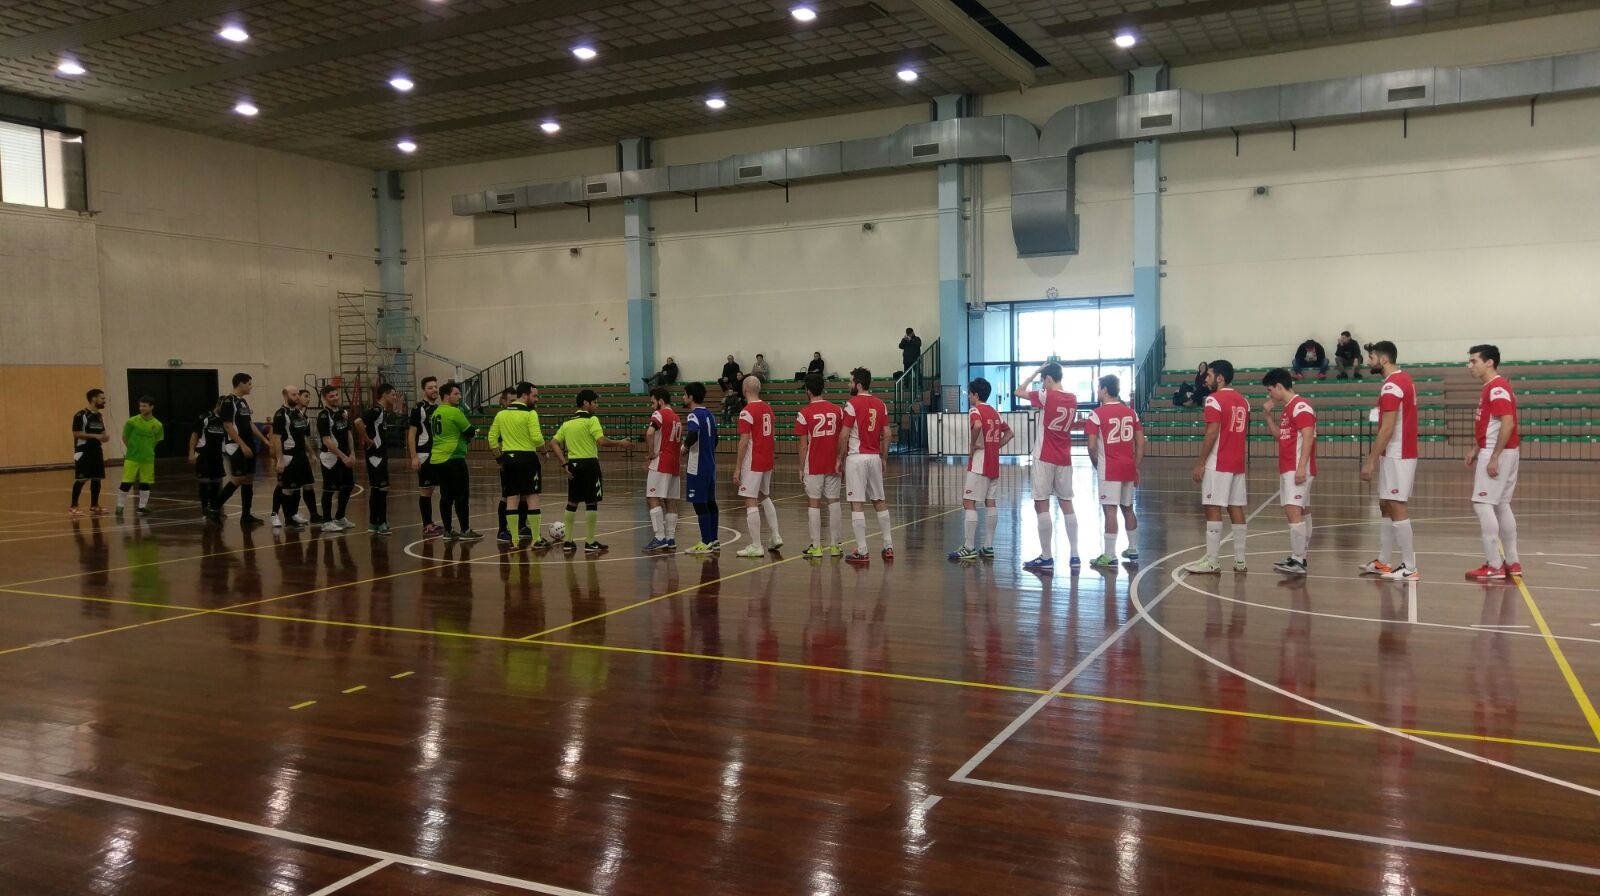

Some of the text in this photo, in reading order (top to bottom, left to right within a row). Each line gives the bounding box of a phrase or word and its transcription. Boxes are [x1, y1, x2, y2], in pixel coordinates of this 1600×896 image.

[706, 416, 712, 437] 1
[762, 413, 772, 436] 8
[812, 412, 837, 437] 23
[867, 408, 877, 431] 3
[1047, 407, 1076, 432] 21
[1106, 416, 1134, 444] 26
[1230, 405, 1246, 432] 19
[670, 420, 682, 442] 10
[986, 419, 1000, 442] 22
